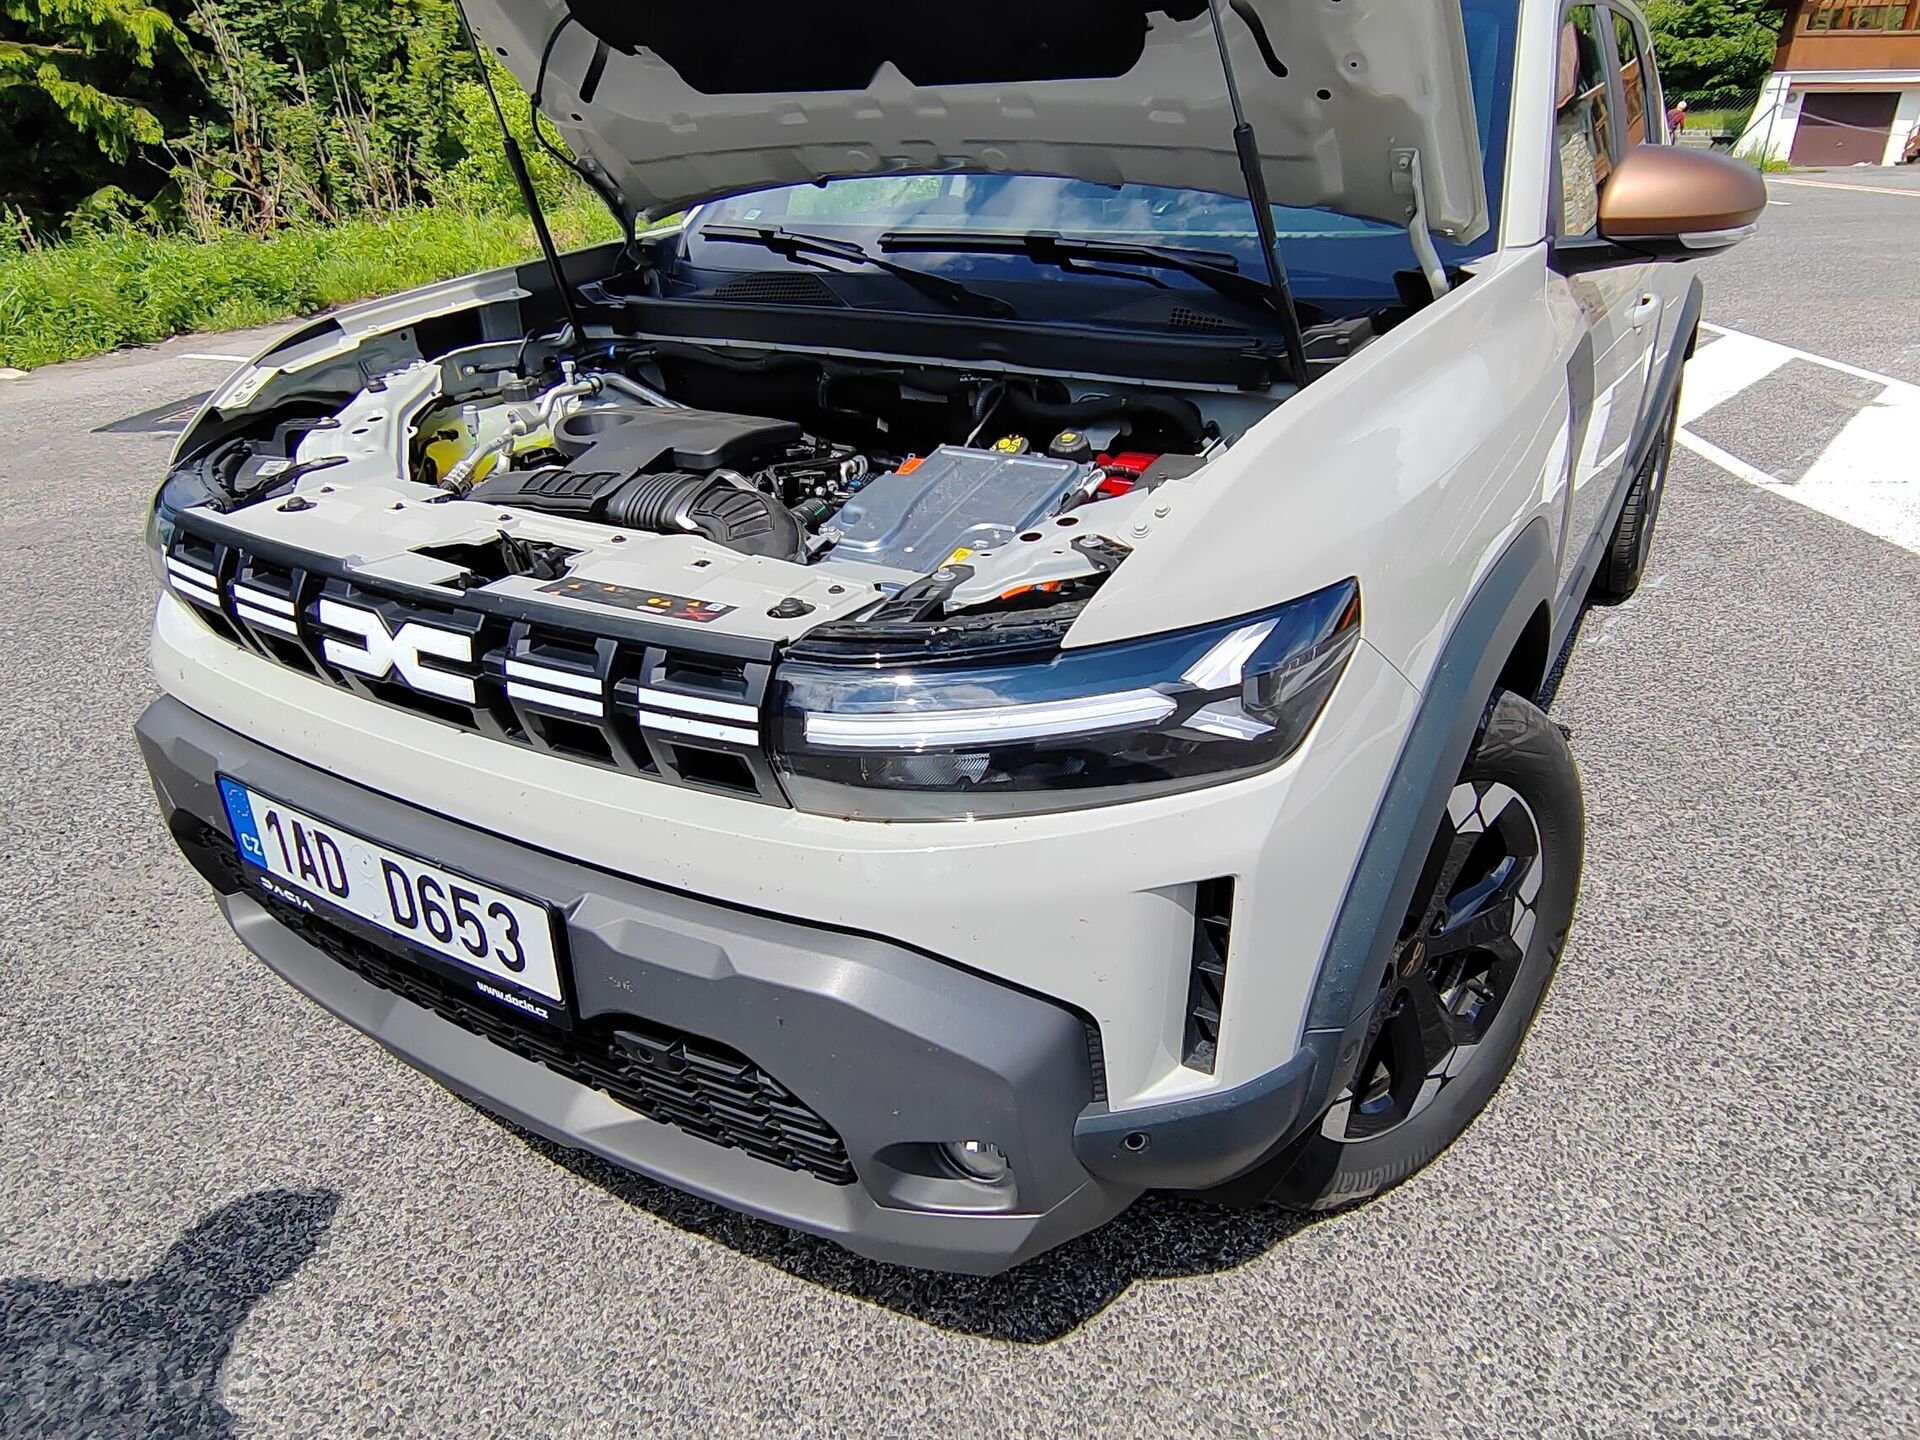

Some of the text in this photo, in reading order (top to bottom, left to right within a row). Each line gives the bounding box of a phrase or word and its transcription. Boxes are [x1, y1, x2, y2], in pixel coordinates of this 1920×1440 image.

[240, 834, 263, 857] CZ
[260, 876, 315, 913] DACIA
[264, 808, 526, 973] 1AD D653
[476, 980, 549, 1019] www.dacia.cz
